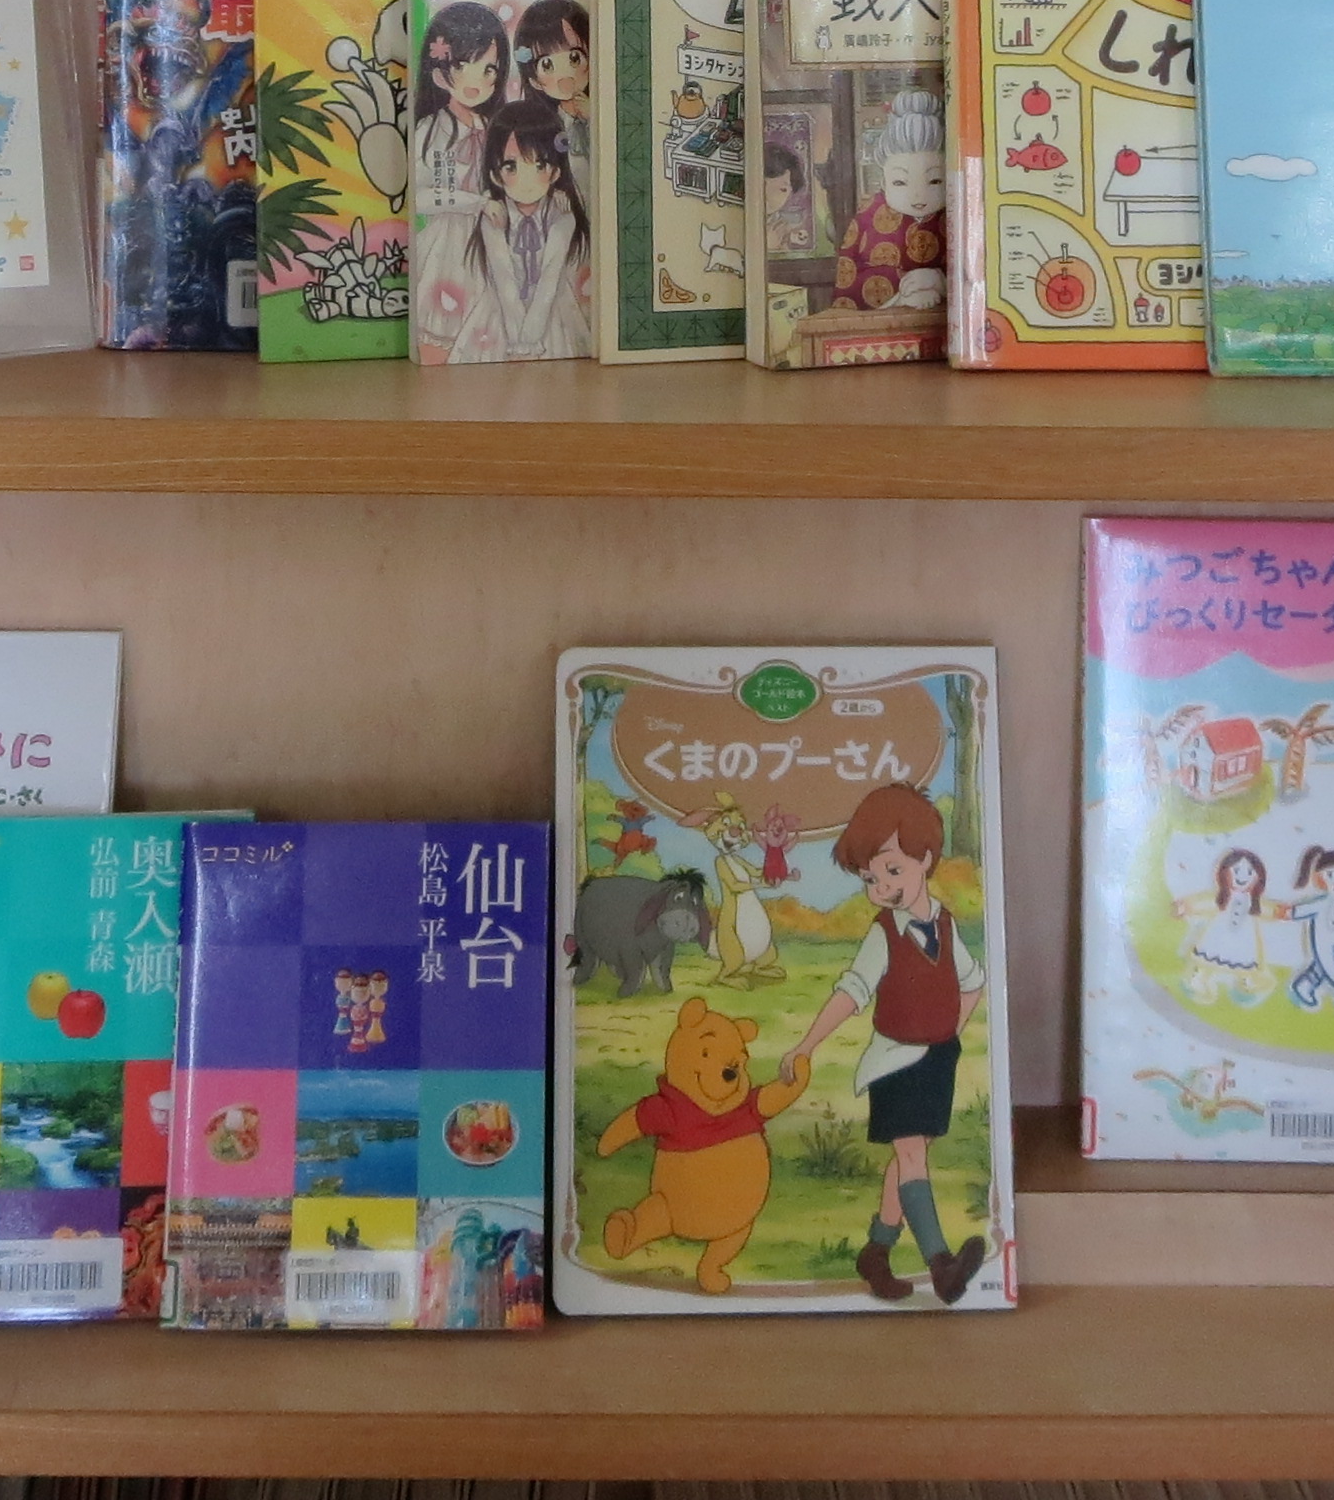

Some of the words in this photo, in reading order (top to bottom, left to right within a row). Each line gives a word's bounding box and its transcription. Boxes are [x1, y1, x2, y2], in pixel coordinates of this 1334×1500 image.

[1157, 263, 1203, 286] ヨシ
[643, 736, 911, 782] くまのプーさん
[88, 836, 121, 900] 弘前
[200, 846, 282, 865] ココミル
[419, 840, 450, 907] 松島
[87, 910, 117, 975] 青森
[457, 840, 526, 990] 仙台
[416, 916, 449, 984] 平泉
